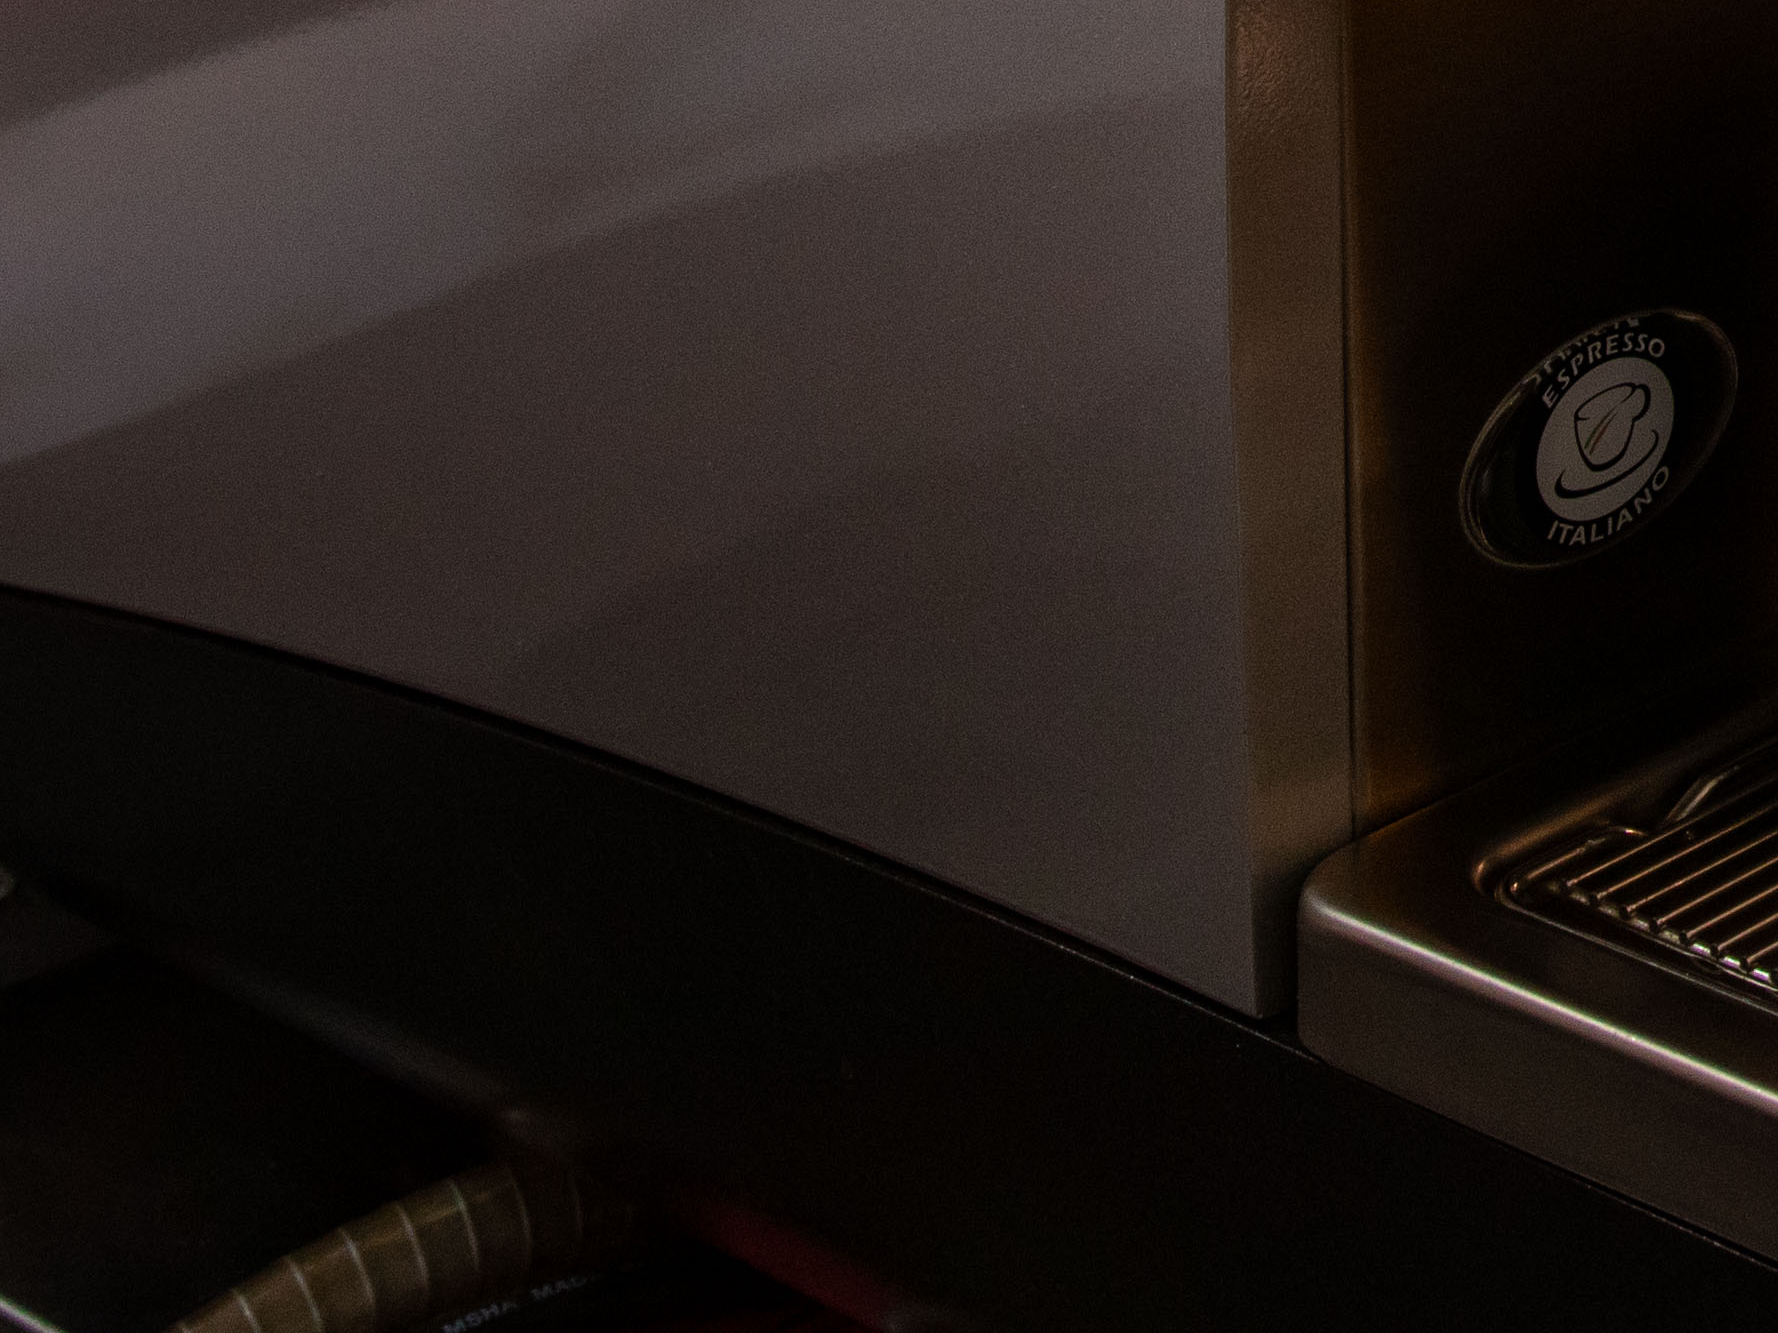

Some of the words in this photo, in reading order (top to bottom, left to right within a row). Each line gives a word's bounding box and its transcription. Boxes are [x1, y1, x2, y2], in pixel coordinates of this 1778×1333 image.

[1541, 331, 1666, 411] ESPRESSO
[1546, 463, 1670, 547] ITALIANO
[530, 1272, 600, 1301] MAD
